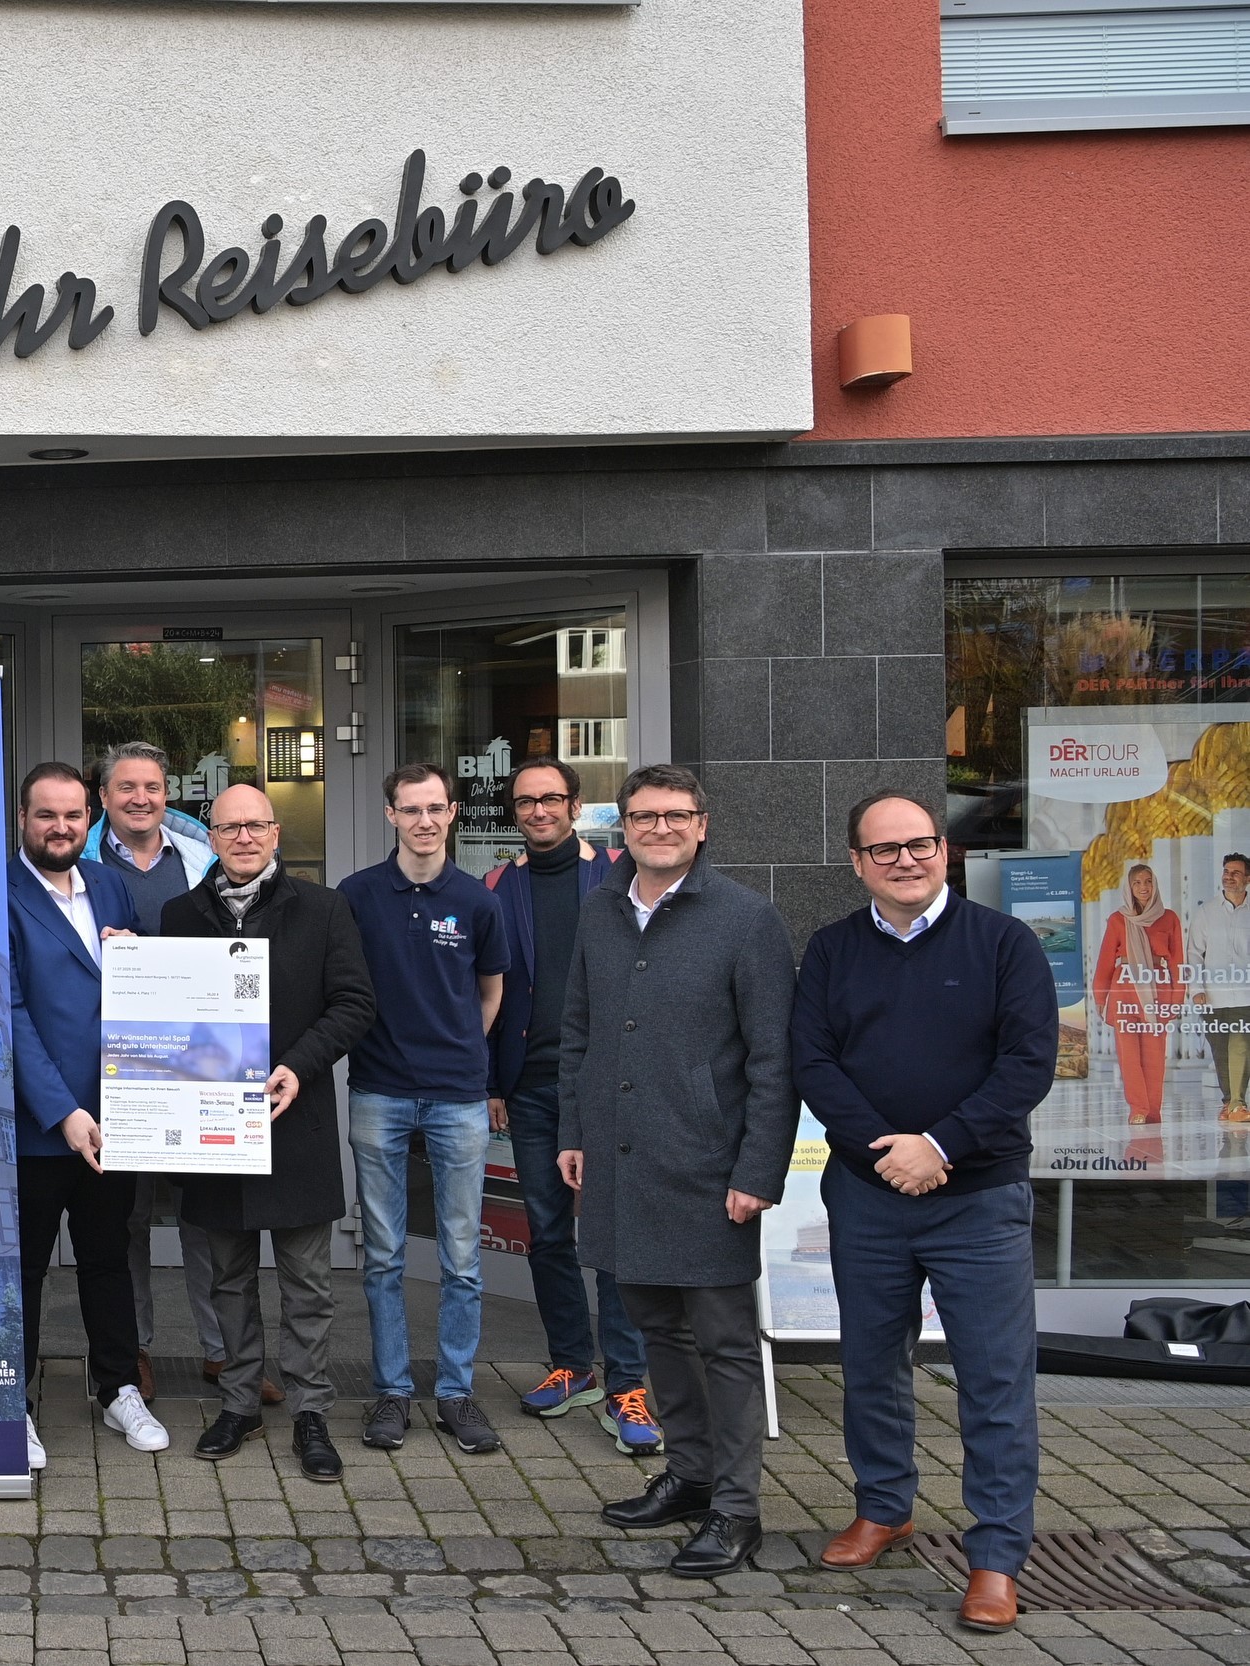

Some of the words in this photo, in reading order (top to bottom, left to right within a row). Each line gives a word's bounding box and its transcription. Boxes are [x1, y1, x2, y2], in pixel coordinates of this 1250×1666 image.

[138, 149, 636, 336] Reisebüro
[1077, 679, 1110, 691] DER
[1050, 768, 1090, 778] MACHT
[1093, 766, 1140, 777] URLAUB
[458, 801, 504, 819] Flugreisen
[1117, 964, 1170, 984] Abu
[1117, 1001, 1139, 1014] Im
[1144, 1000, 1214, 1018] eigenen
[1117, 1020, 1175, 1036] Tempo
[1180, 1019, 1250, 1033] entdeck
[140, 1043, 188, 1051] Unterhaltung!
[800, 1146, 827, 1154] sofort
[1054, 1147, 1105, 1155] experience
[1051, 1157, 1088, 1170] abu
[1092, 1156, 1148, 1171] dhabi
[813, 1286, 830, 1294] Hier
